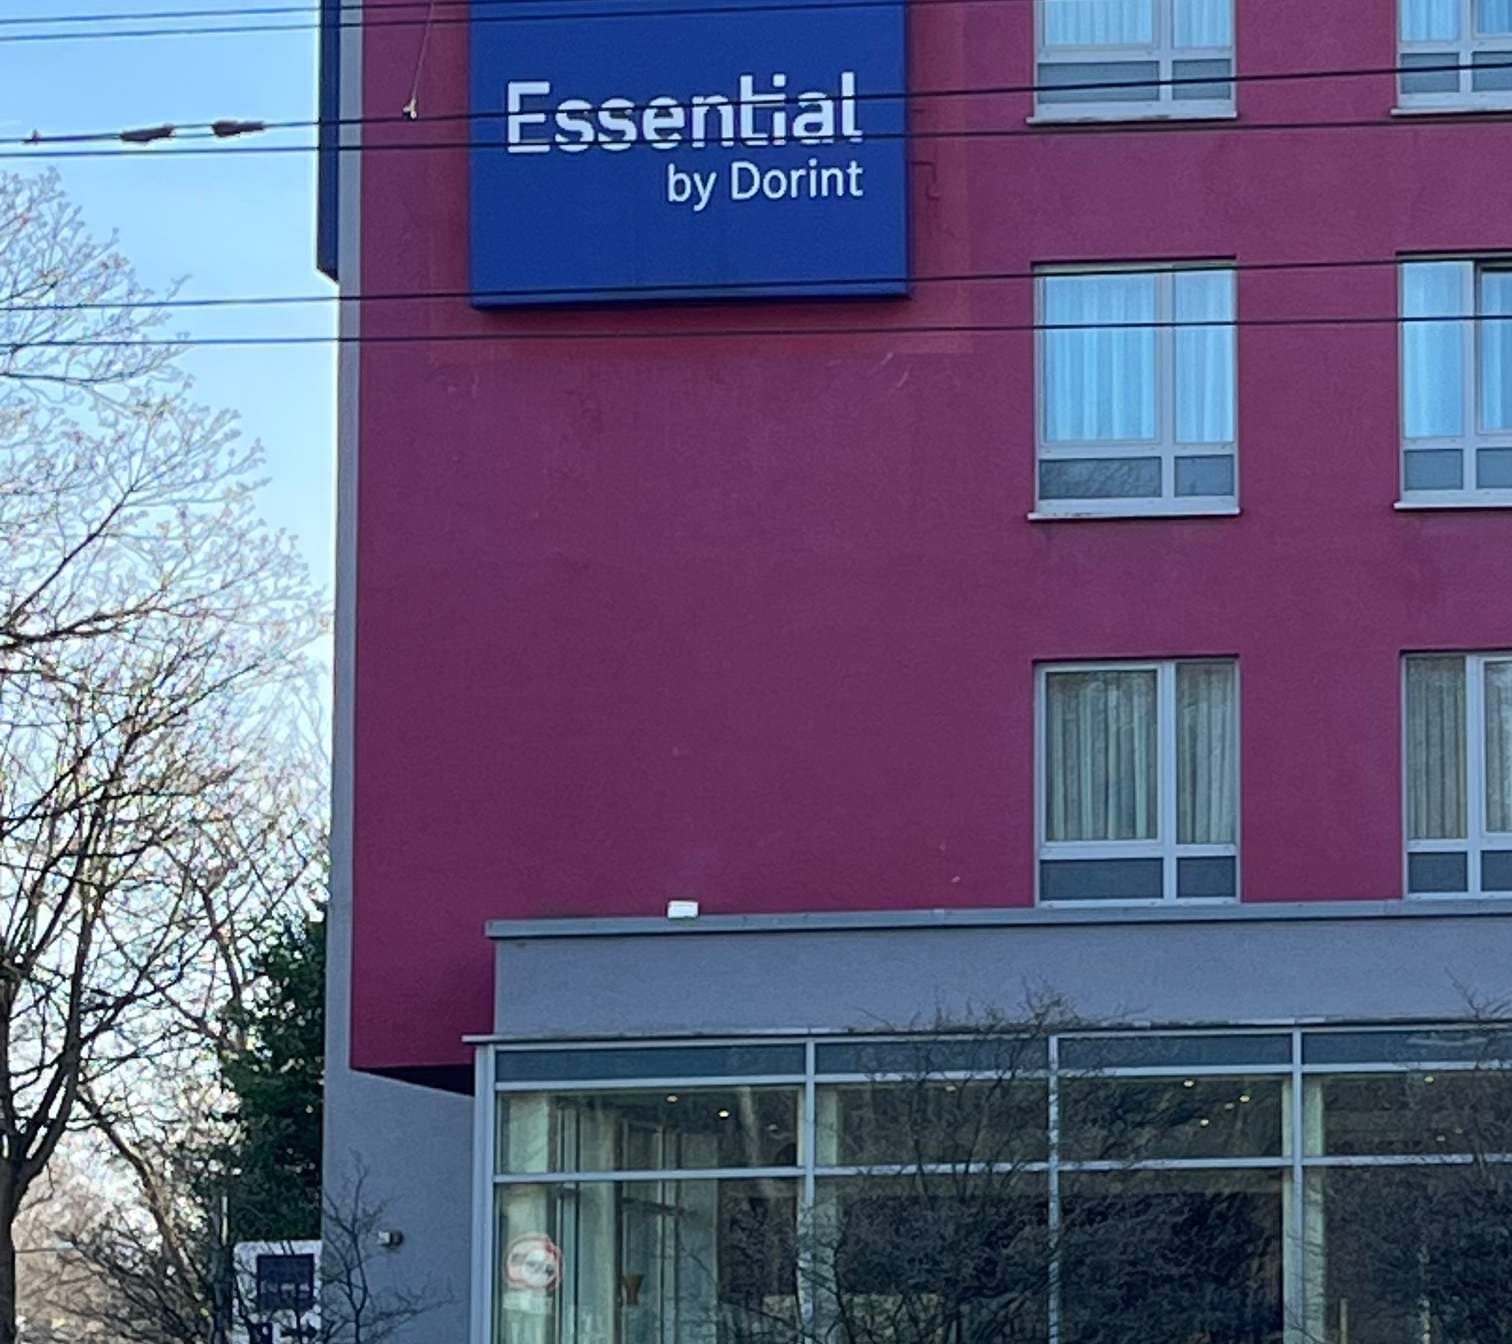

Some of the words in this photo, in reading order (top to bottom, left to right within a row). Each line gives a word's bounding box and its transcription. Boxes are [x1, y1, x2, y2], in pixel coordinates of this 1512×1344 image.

[507, 71, 863, 153] Essential
[668, 163, 717, 212] by
[731, 158, 863, 200] Dorint
